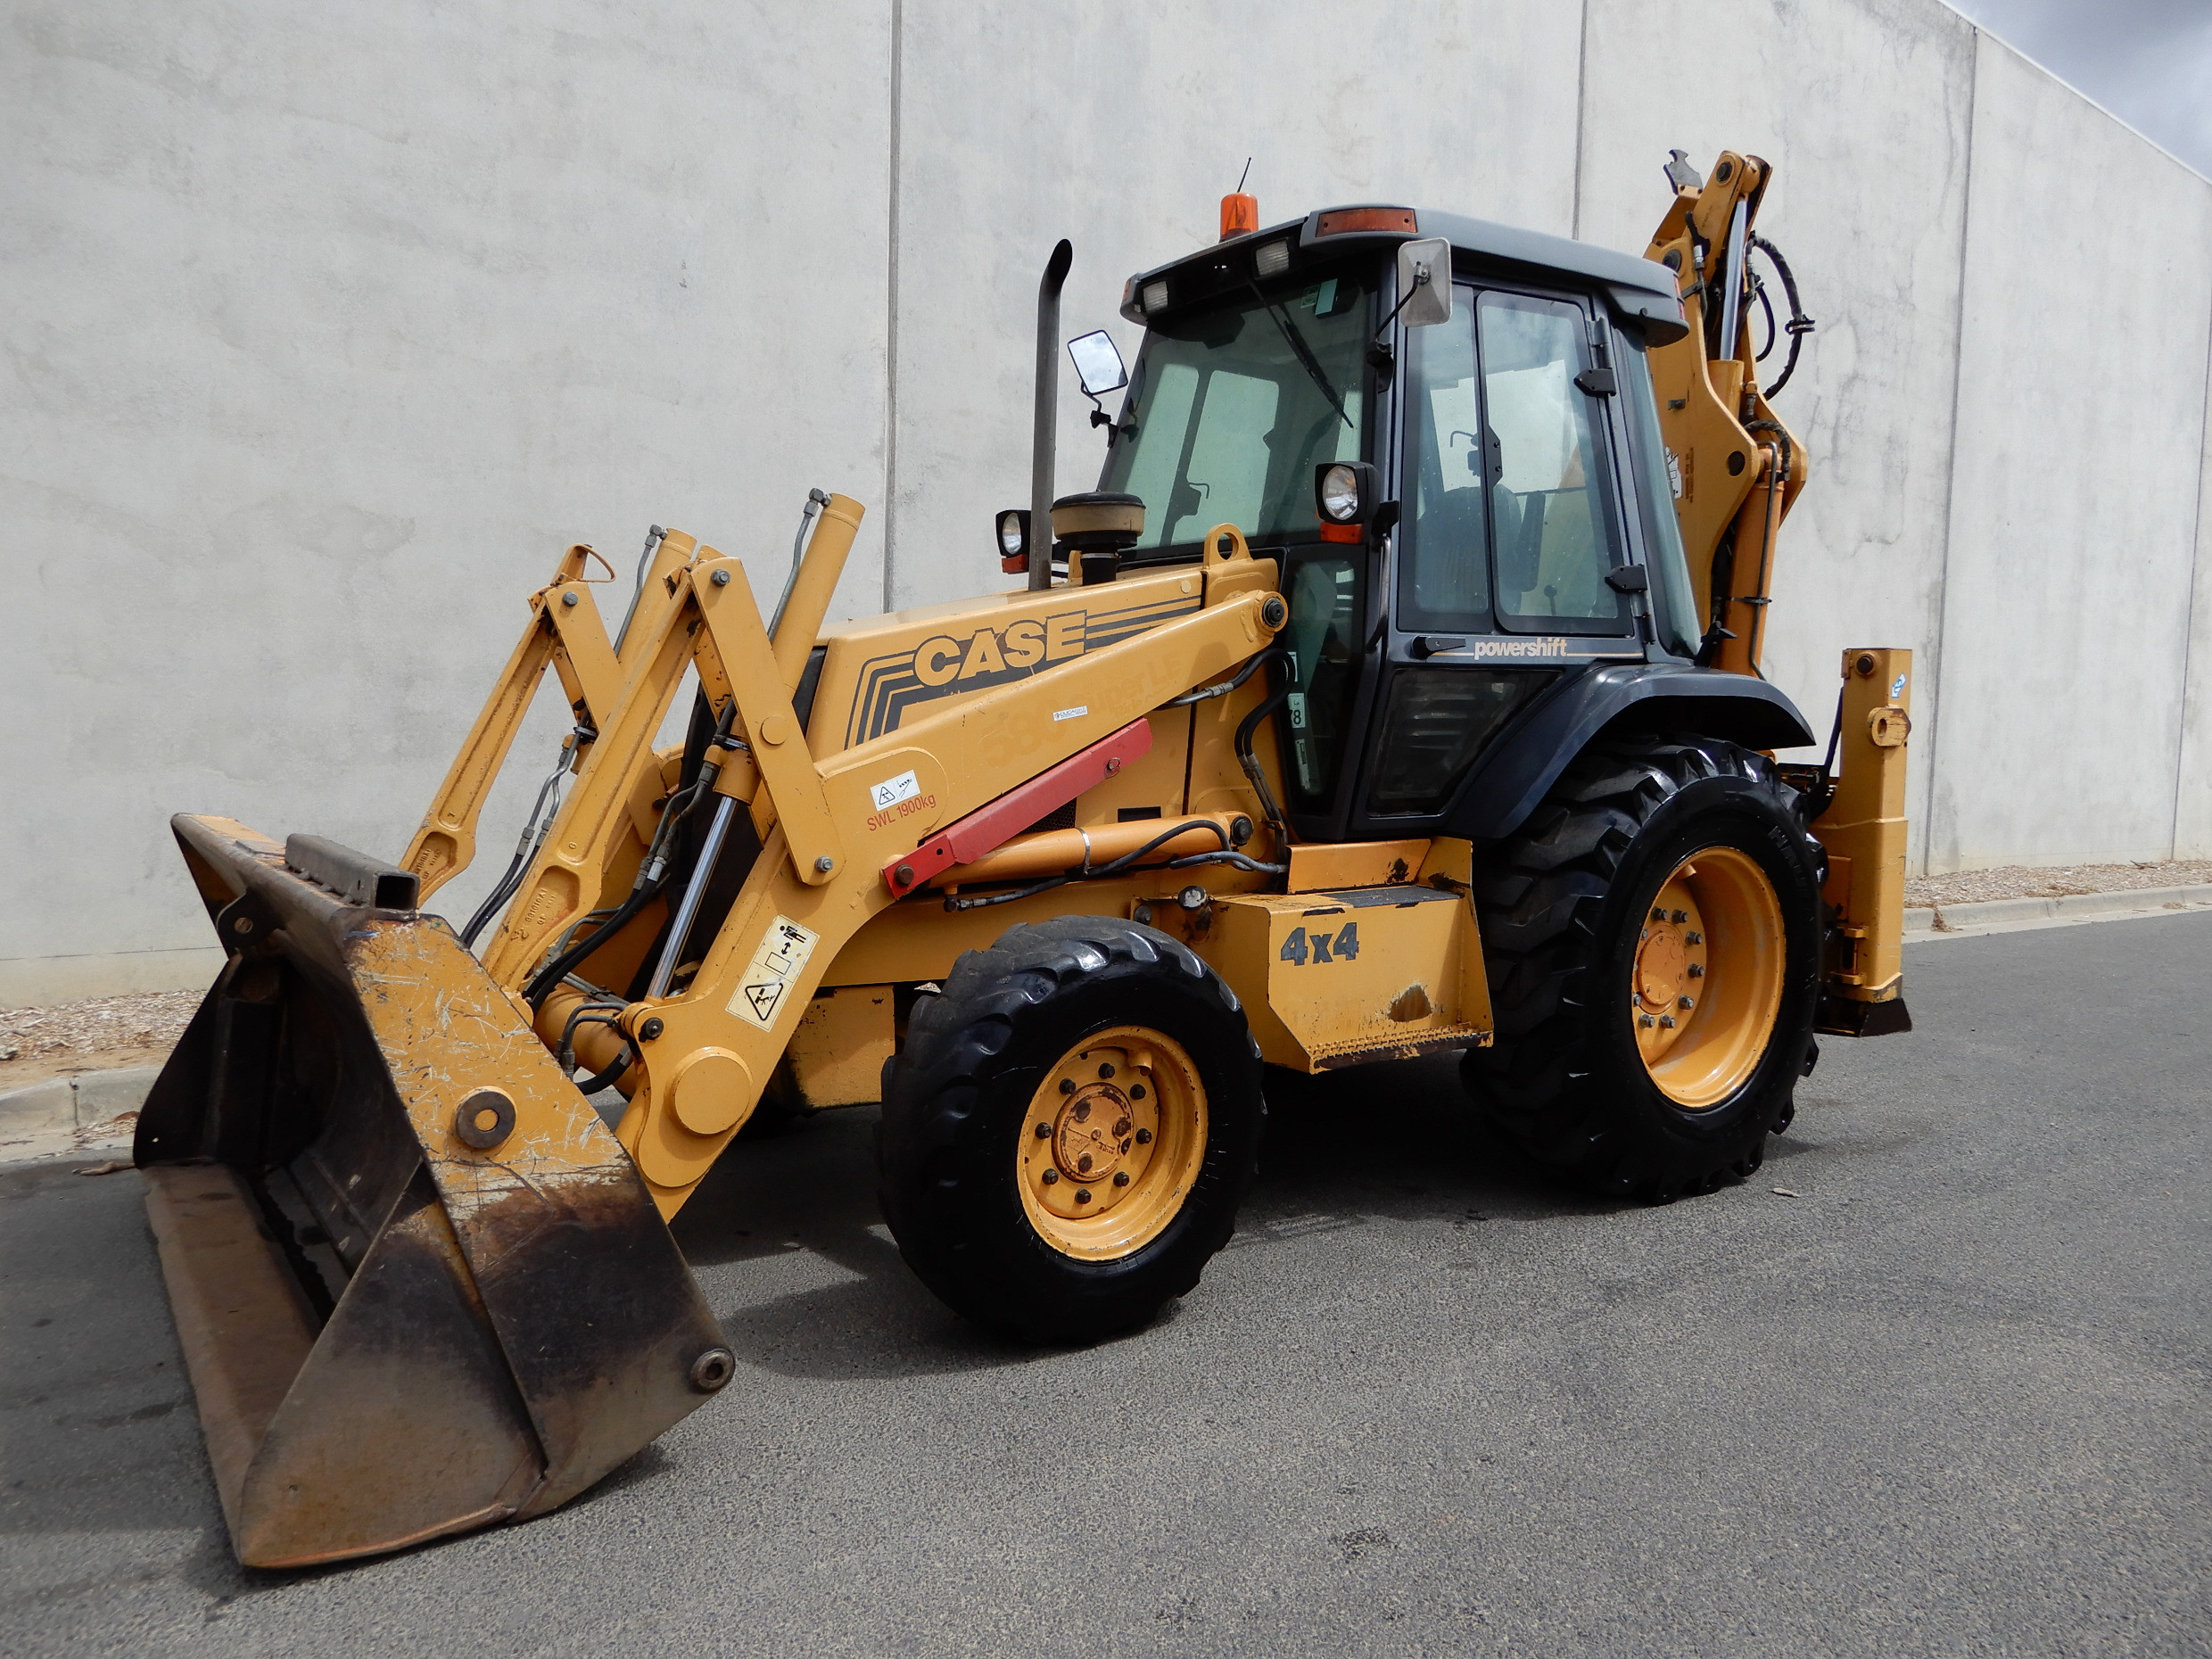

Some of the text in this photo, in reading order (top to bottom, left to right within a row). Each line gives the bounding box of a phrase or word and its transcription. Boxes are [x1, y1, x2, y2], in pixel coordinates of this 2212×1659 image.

[914, 610, 1087, 687] CASE
[1473, 638, 1567, 660] powershift
[867, 794, 937, 831] SWL 1900kg
[1280, 922, 1360, 967] 4x4
